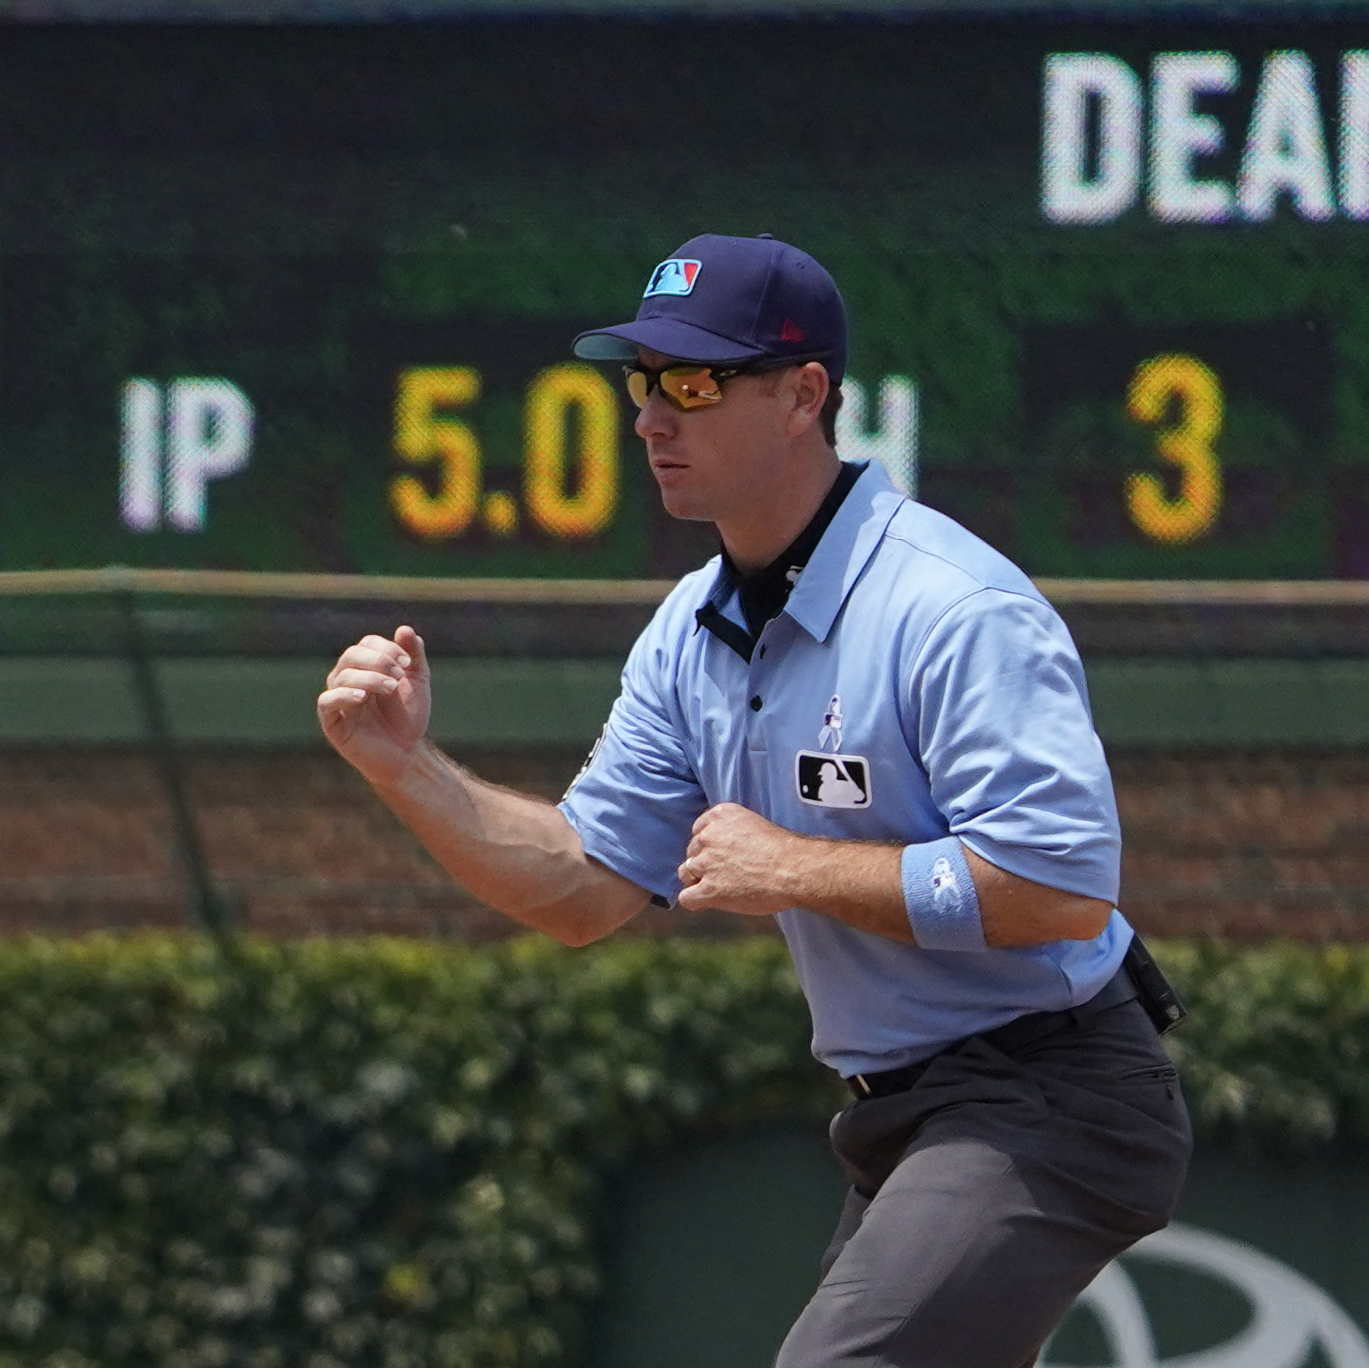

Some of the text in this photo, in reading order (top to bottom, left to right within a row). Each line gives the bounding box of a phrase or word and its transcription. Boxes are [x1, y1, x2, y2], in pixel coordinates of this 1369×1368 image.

[1040, 49, 1369, 224] DEA
[119, 376, 256, 531] IP
[389, 364, 620, 539] 5.0
[1124, 352, 1224, 545] 3
